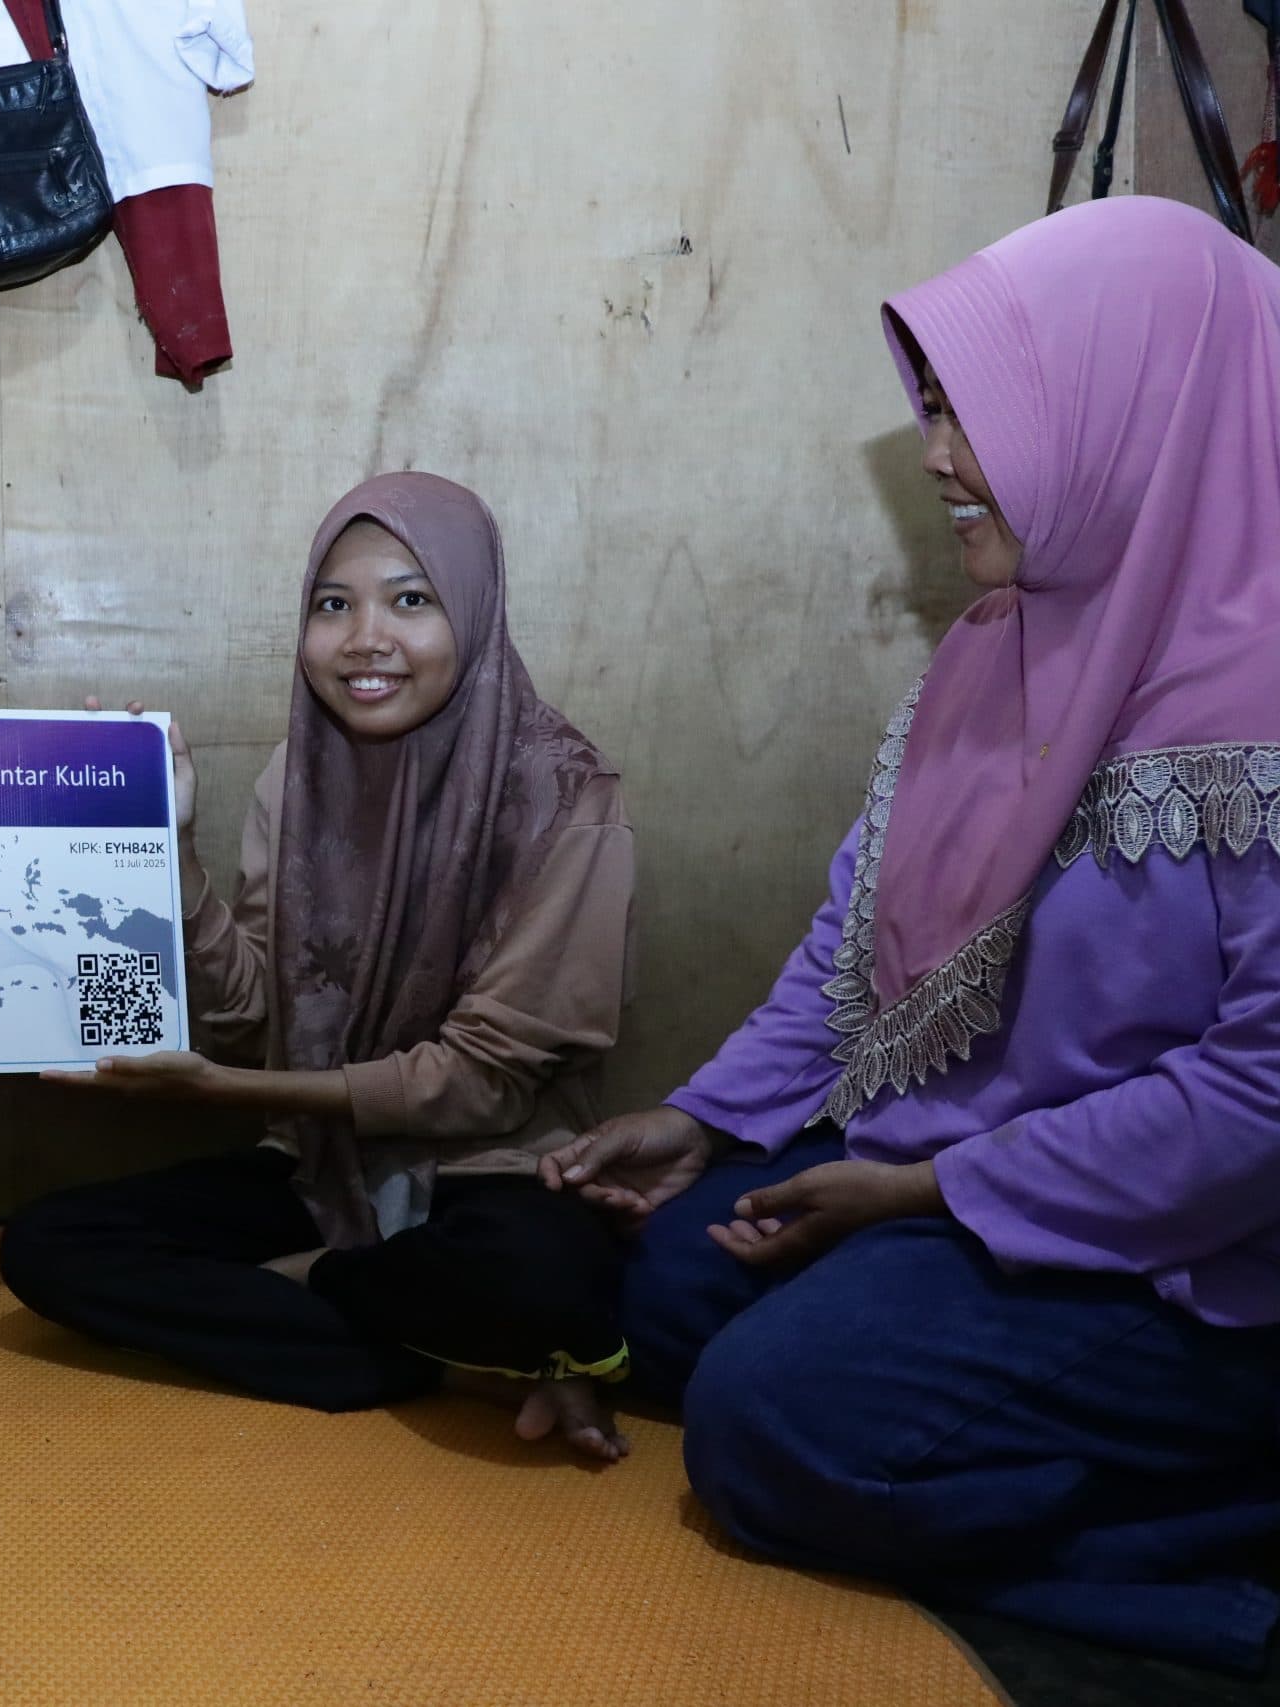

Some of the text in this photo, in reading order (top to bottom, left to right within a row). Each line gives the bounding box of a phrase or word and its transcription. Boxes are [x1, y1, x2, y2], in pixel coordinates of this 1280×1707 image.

[55, 765, 125, 787] Kuliah
[70, 842, 165, 854] KIPK: EYH842K
[114, 859, 166, 868] 11 Juli 2025
